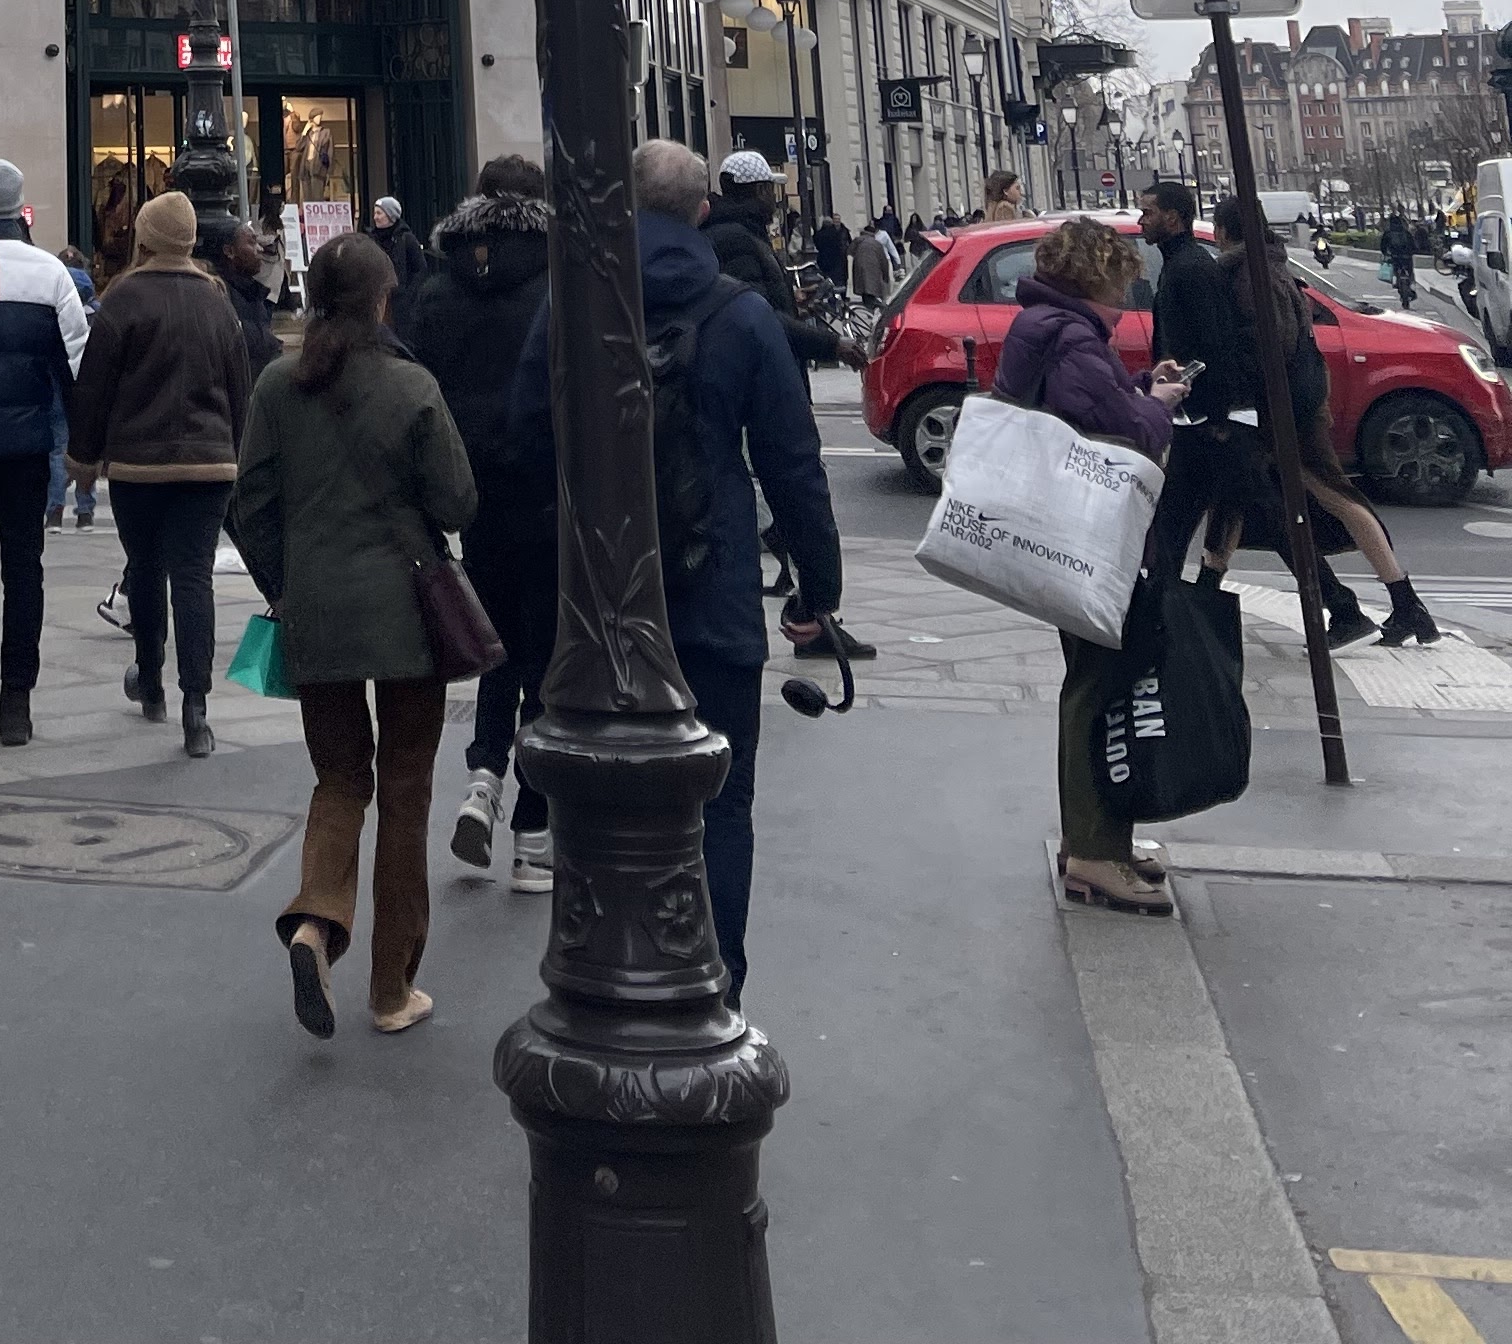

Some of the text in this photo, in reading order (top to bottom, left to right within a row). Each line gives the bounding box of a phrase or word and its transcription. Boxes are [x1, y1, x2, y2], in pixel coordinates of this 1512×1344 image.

[305, 203, 350, 215] SOLDES
[1070, 442, 1101, 463] NIKE
[1067, 451, 1116, 479] HOUSE
[947, 498, 976, 518] NIKE
[943, 511, 1095, 578] HOUSE OF INNOVATION
[1133, 666, 1166, 738] BAN
